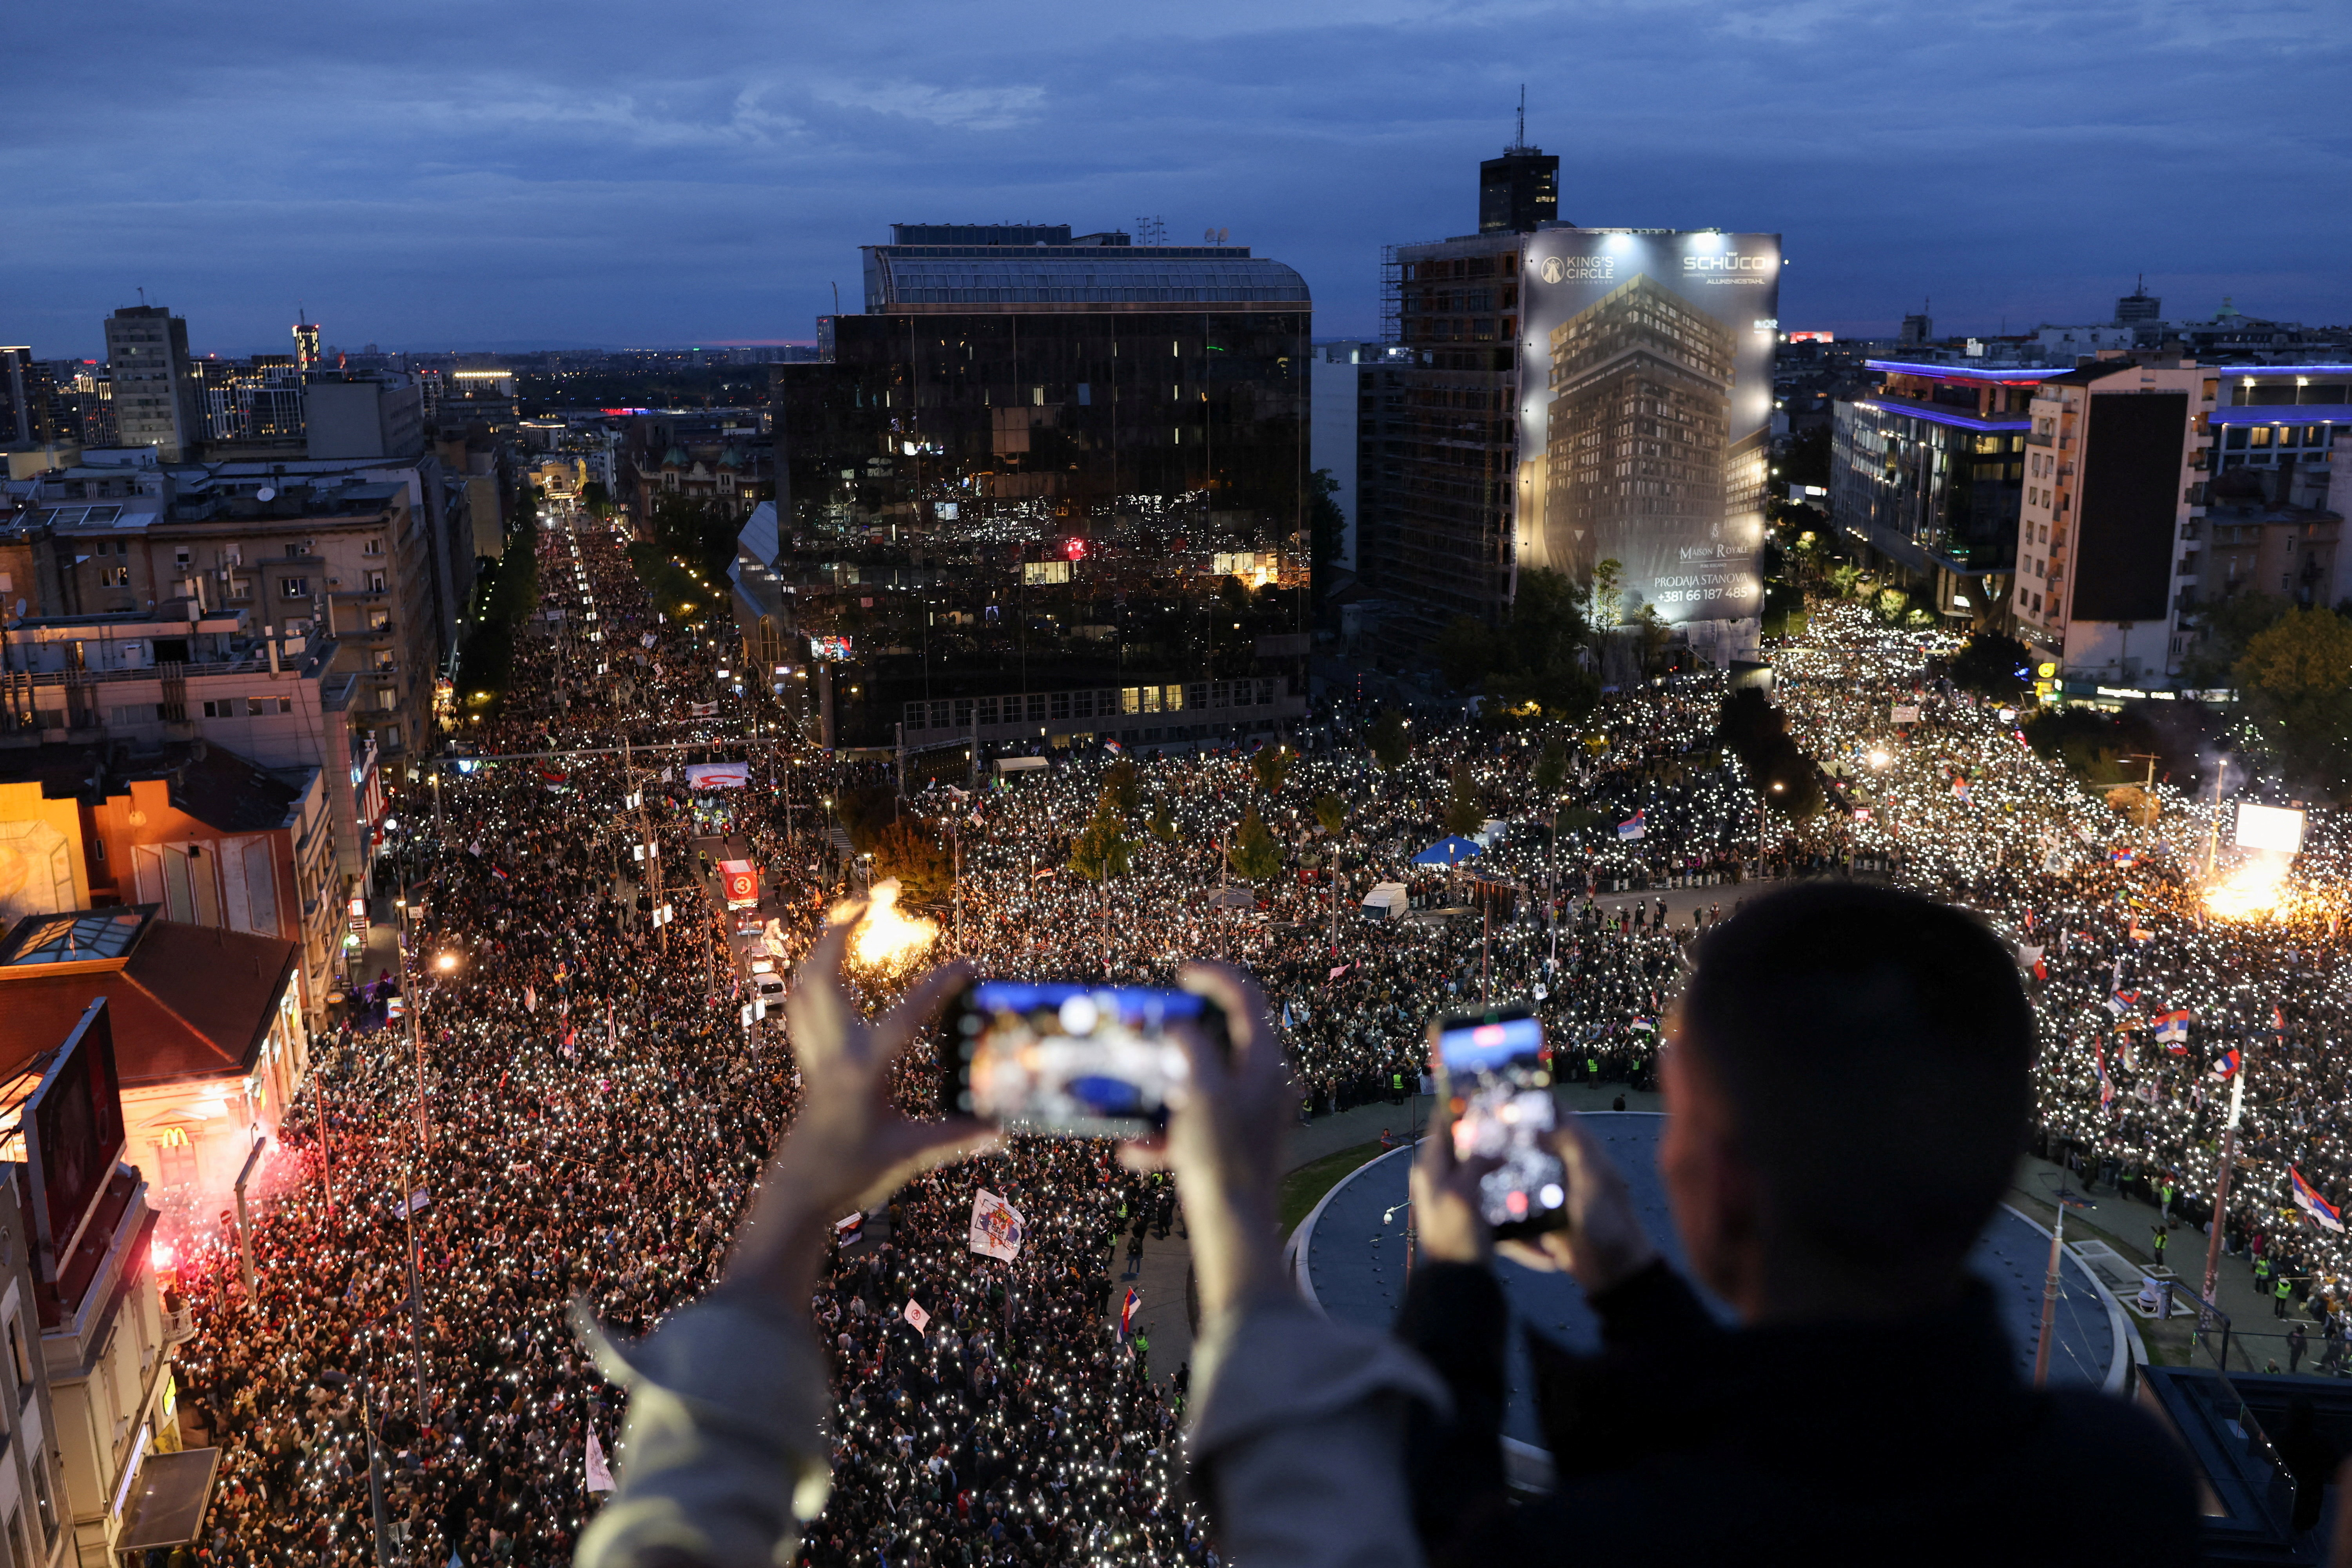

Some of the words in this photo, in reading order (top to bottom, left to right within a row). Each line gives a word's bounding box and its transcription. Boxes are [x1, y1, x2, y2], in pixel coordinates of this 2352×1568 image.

[1567, 256, 1614, 268] KING'S
[1683, 252, 1766, 270] SCHÜCO
[1566, 269, 1614, 279] CIRCLE
[1680, 546, 1713, 559] MAISON
[1717, 544, 1749, 557] ROYALE
[1655, 575, 1699, 588] PRODAJA
[1701, 572, 1748, 585] STANOVA
[1658, 590, 1682, 603] +381
[1686, 589, 1701, 601] 66
[1704, 588, 1722, 600] 187
[1725, 586, 1748, 598] 485
[737, 878, 748, 892] 3
